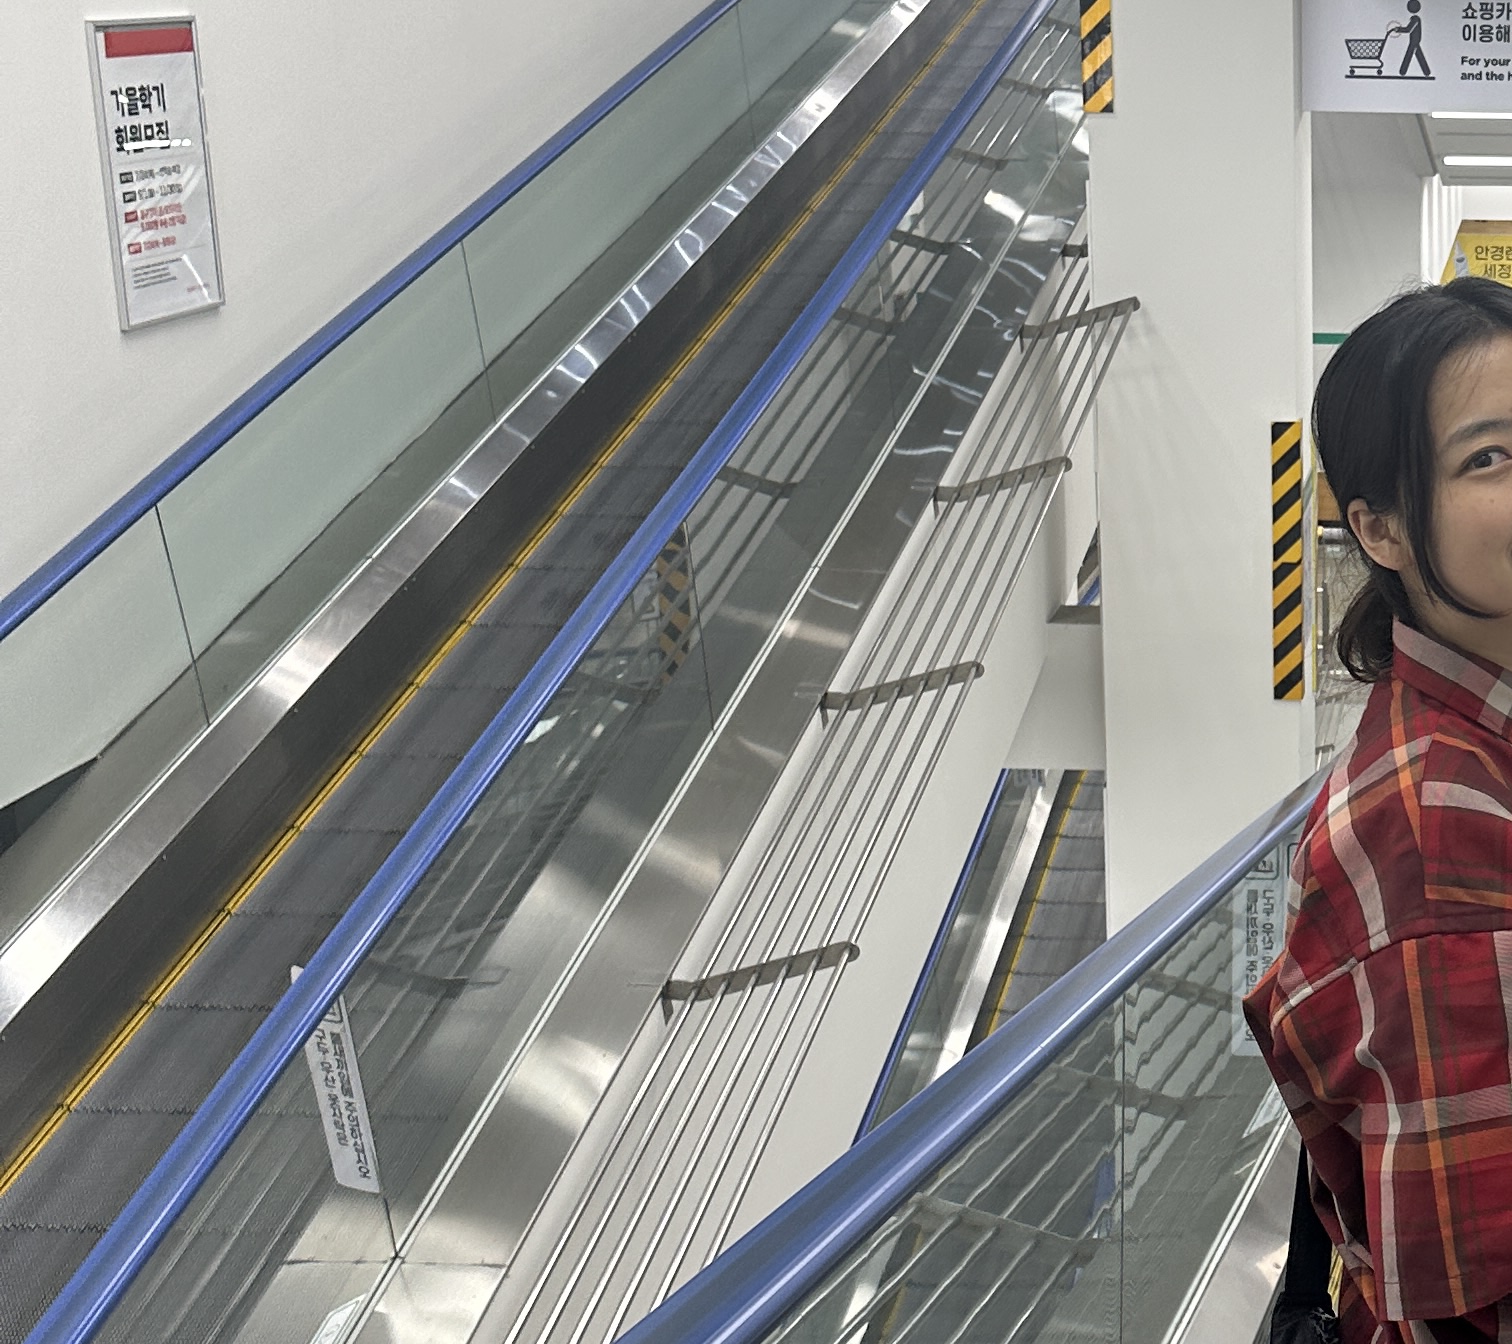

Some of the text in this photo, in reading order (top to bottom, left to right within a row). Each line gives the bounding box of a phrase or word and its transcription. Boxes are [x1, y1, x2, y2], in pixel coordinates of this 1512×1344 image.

[1462, 24, 1511, 43] 이용해
[1461, 56, 1481, 66] For
[1484, 58, 1511, 68] your
[1460, 71, 1482, 81] and
[1485, 71, 1504, 81] the
[110, 83, 166, 117] 가을학기
